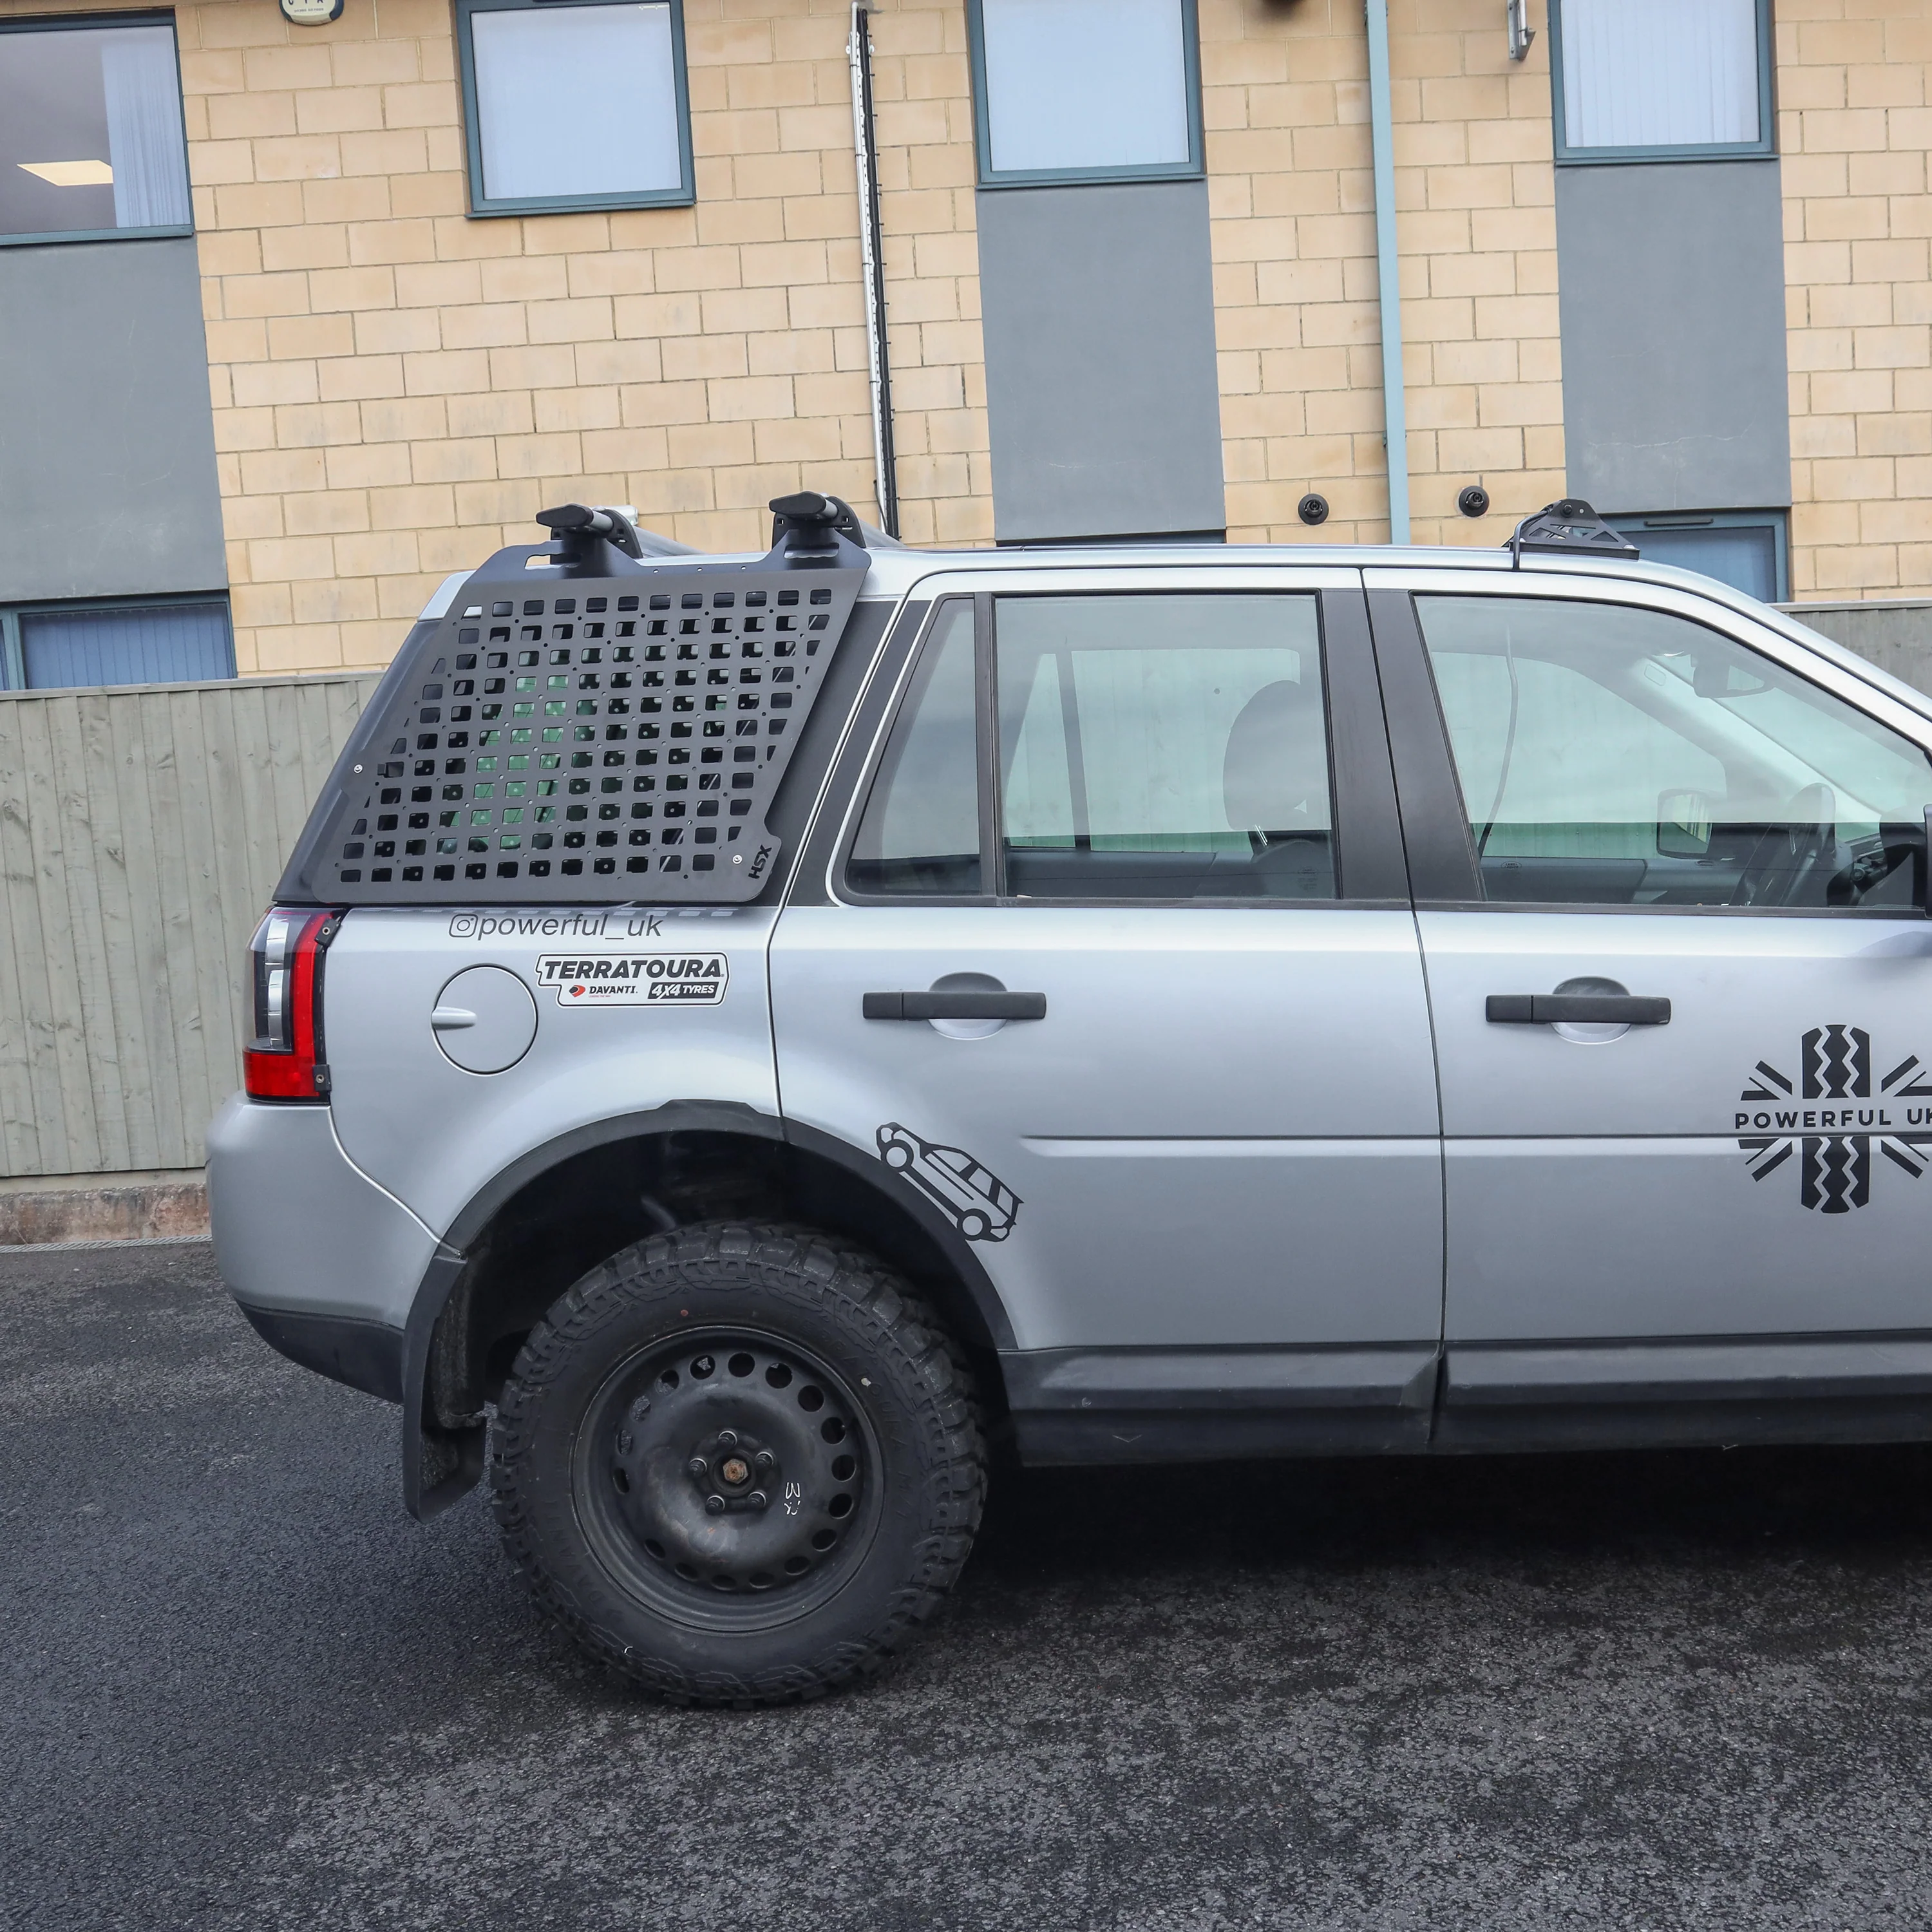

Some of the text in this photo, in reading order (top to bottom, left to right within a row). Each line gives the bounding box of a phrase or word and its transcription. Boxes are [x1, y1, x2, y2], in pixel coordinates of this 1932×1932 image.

[748, 844, 772, 879] HSX
[545, 959, 721, 979] TERRATOURA
[683, 985, 714, 994] TYRES
[1735, 1109, 1891, 1129] POWERFUL
